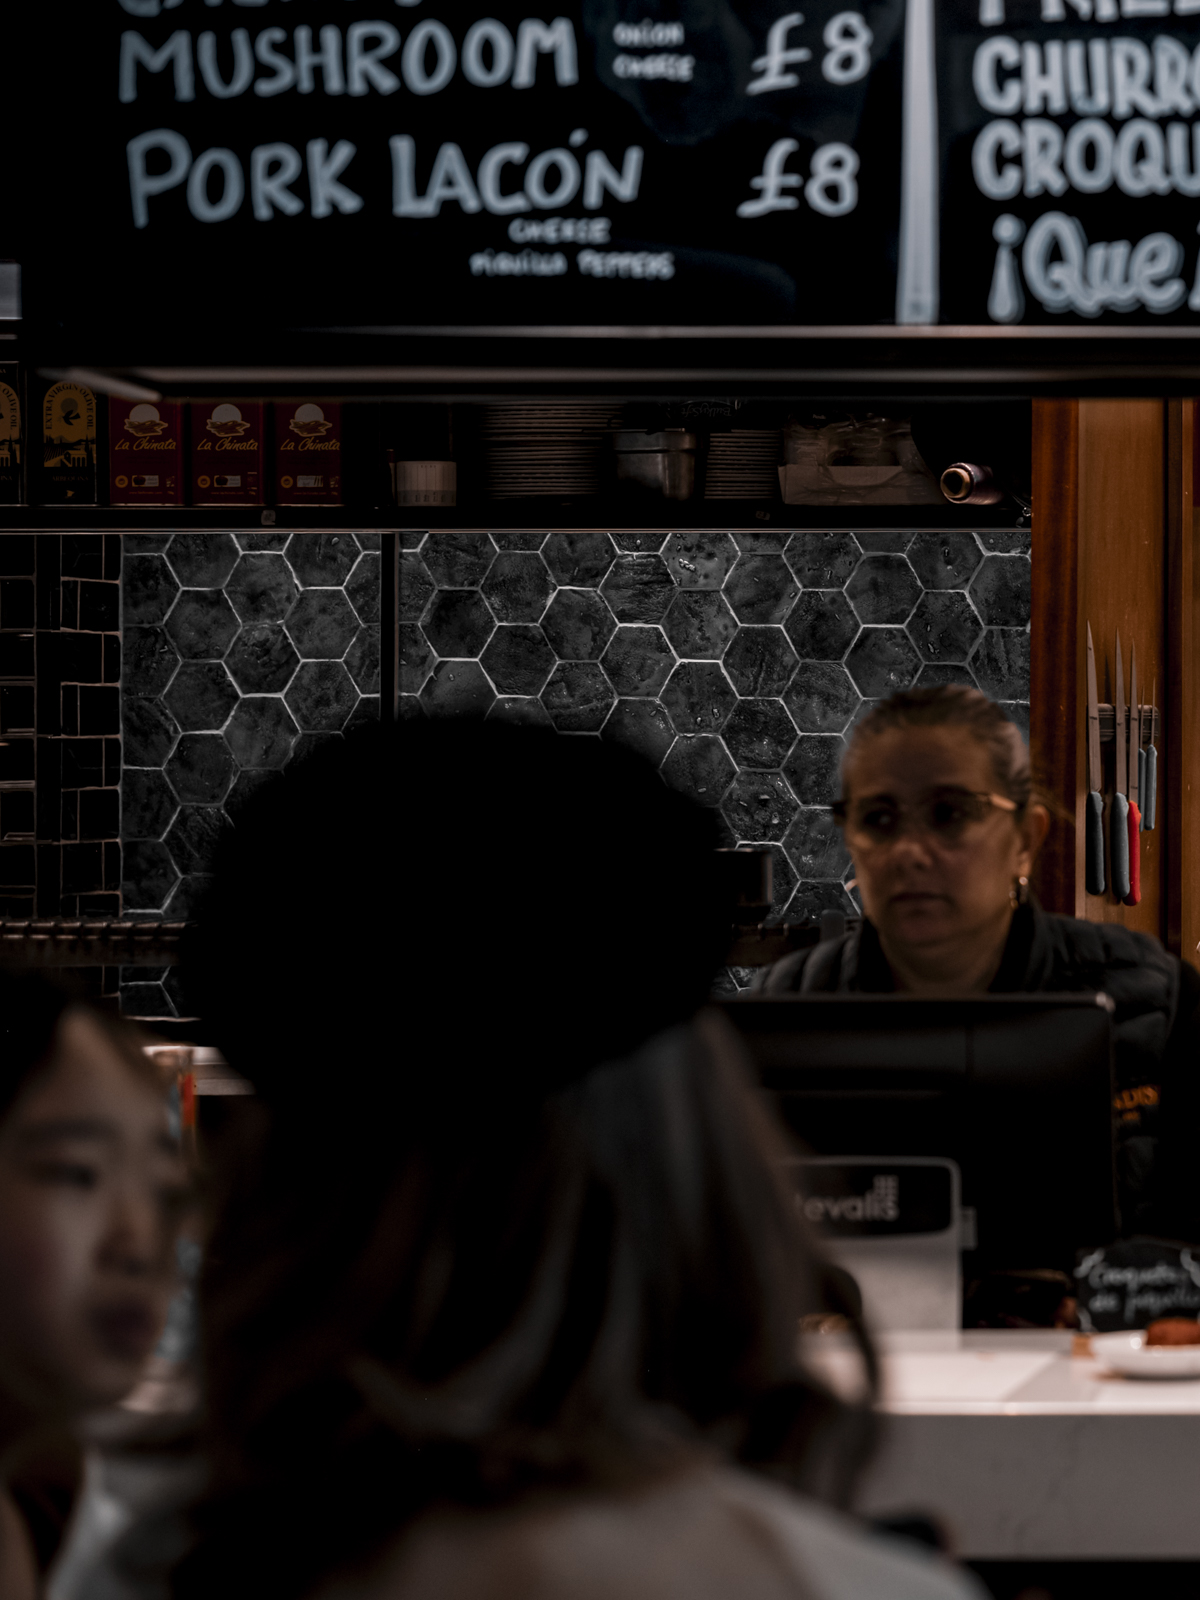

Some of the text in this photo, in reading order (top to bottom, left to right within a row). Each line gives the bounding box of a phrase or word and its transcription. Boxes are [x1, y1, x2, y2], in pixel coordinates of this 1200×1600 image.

[119, 19, 578, 102] MUSHROOM
[746, 11, 874, 95] £8
[126, 129, 643, 227] PORK LACÓN
[737, 138, 860, 217] £8
[988, 211, 1187, 323] ¡Que
[45, 399, 53, 430] EXTRA
[115, 437, 177, 451] La Chinata
[197, 437, 258, 451] La Chinata
[280, 437, 341, 451] La Chinata
[795, 1188, 901, 1222] evalis
